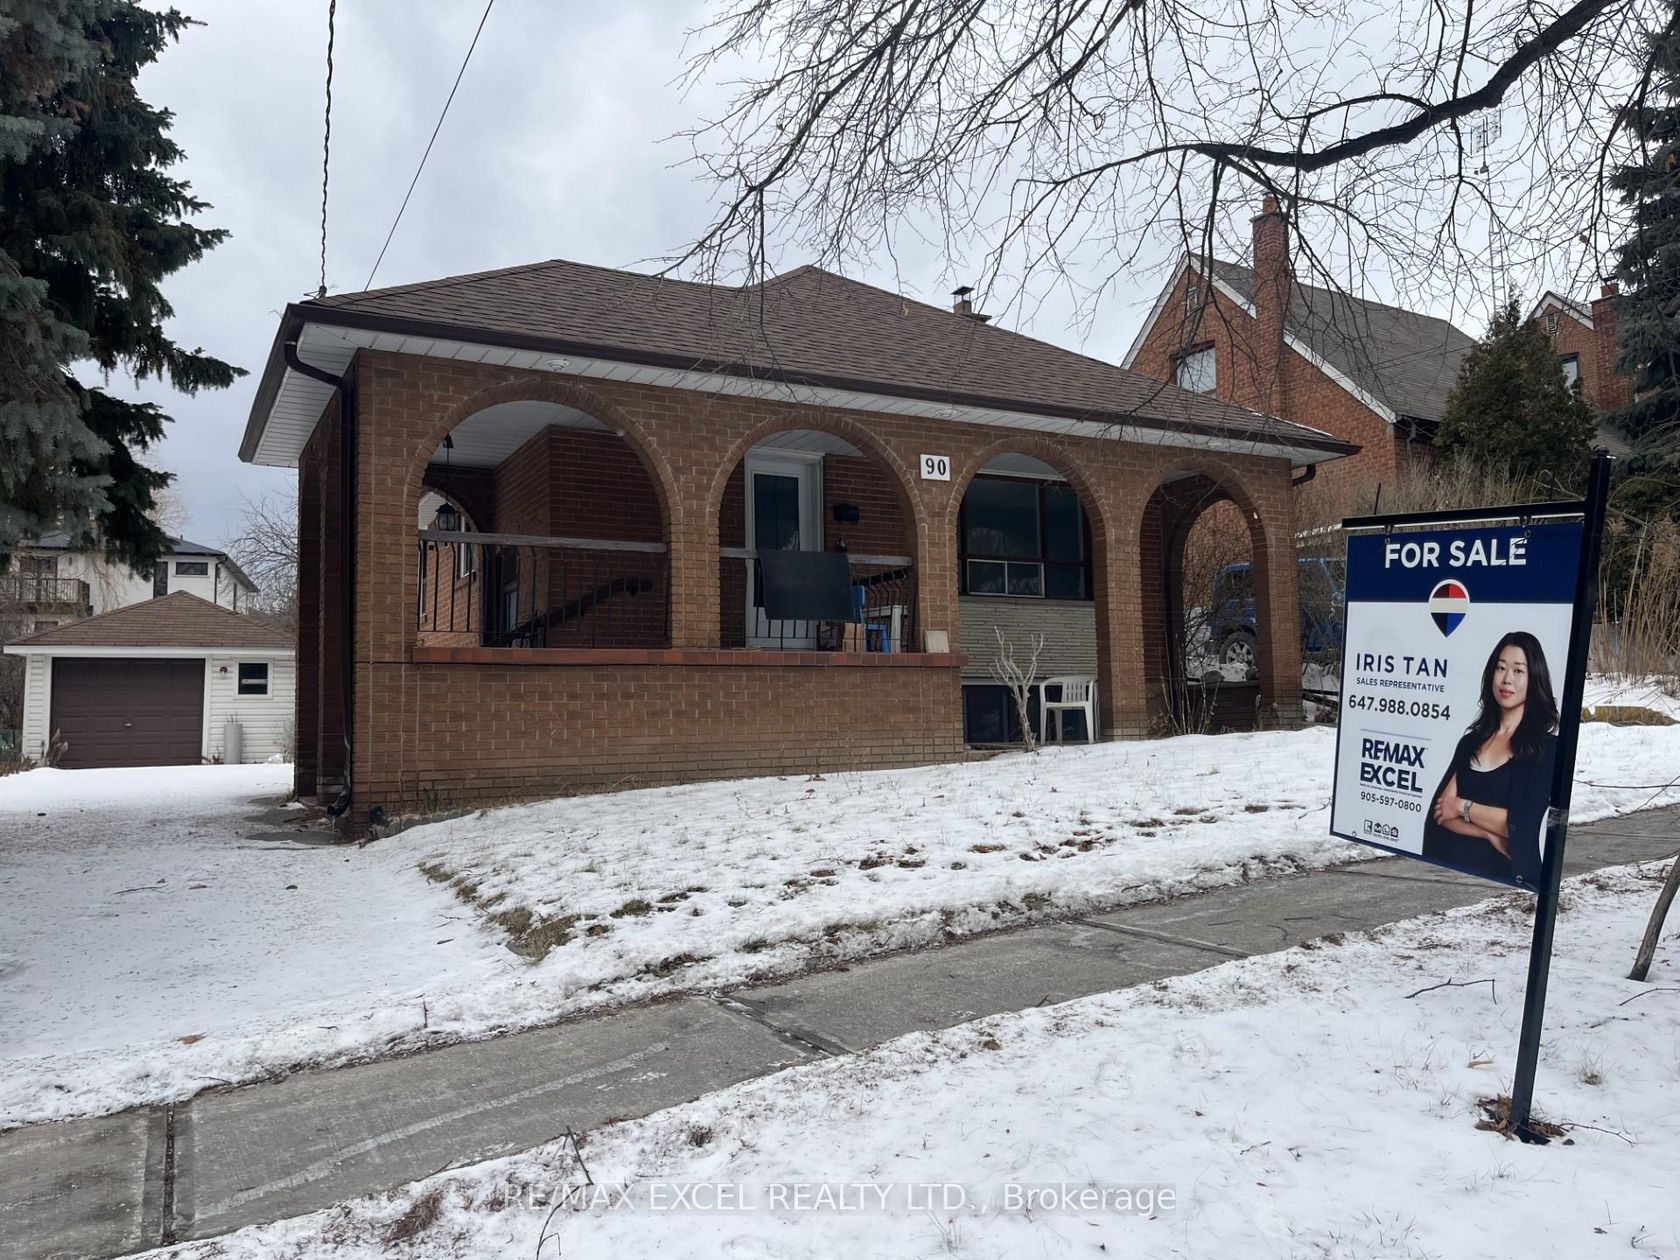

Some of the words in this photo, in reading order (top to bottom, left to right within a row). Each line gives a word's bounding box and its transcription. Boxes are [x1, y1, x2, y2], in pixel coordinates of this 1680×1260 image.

[926, 457, 947, 476] 90
[1385, 541, 1440, 568] FOR
[1449, 537, 1528, 568] SALE
[1356, 652, 1395, 674] IRIS
[1403, 655, 1448, 678] TAN
[1356, 676, 1378, 687] SALES
[1379, 679, 1445, 693] REPRESENTATIVE
[1348, 694, 1451, 721] 647.988.0854
[1360, 761, 1423, 793] EXCEL
[1360, 791, 1422, 813] 905-597-0800
